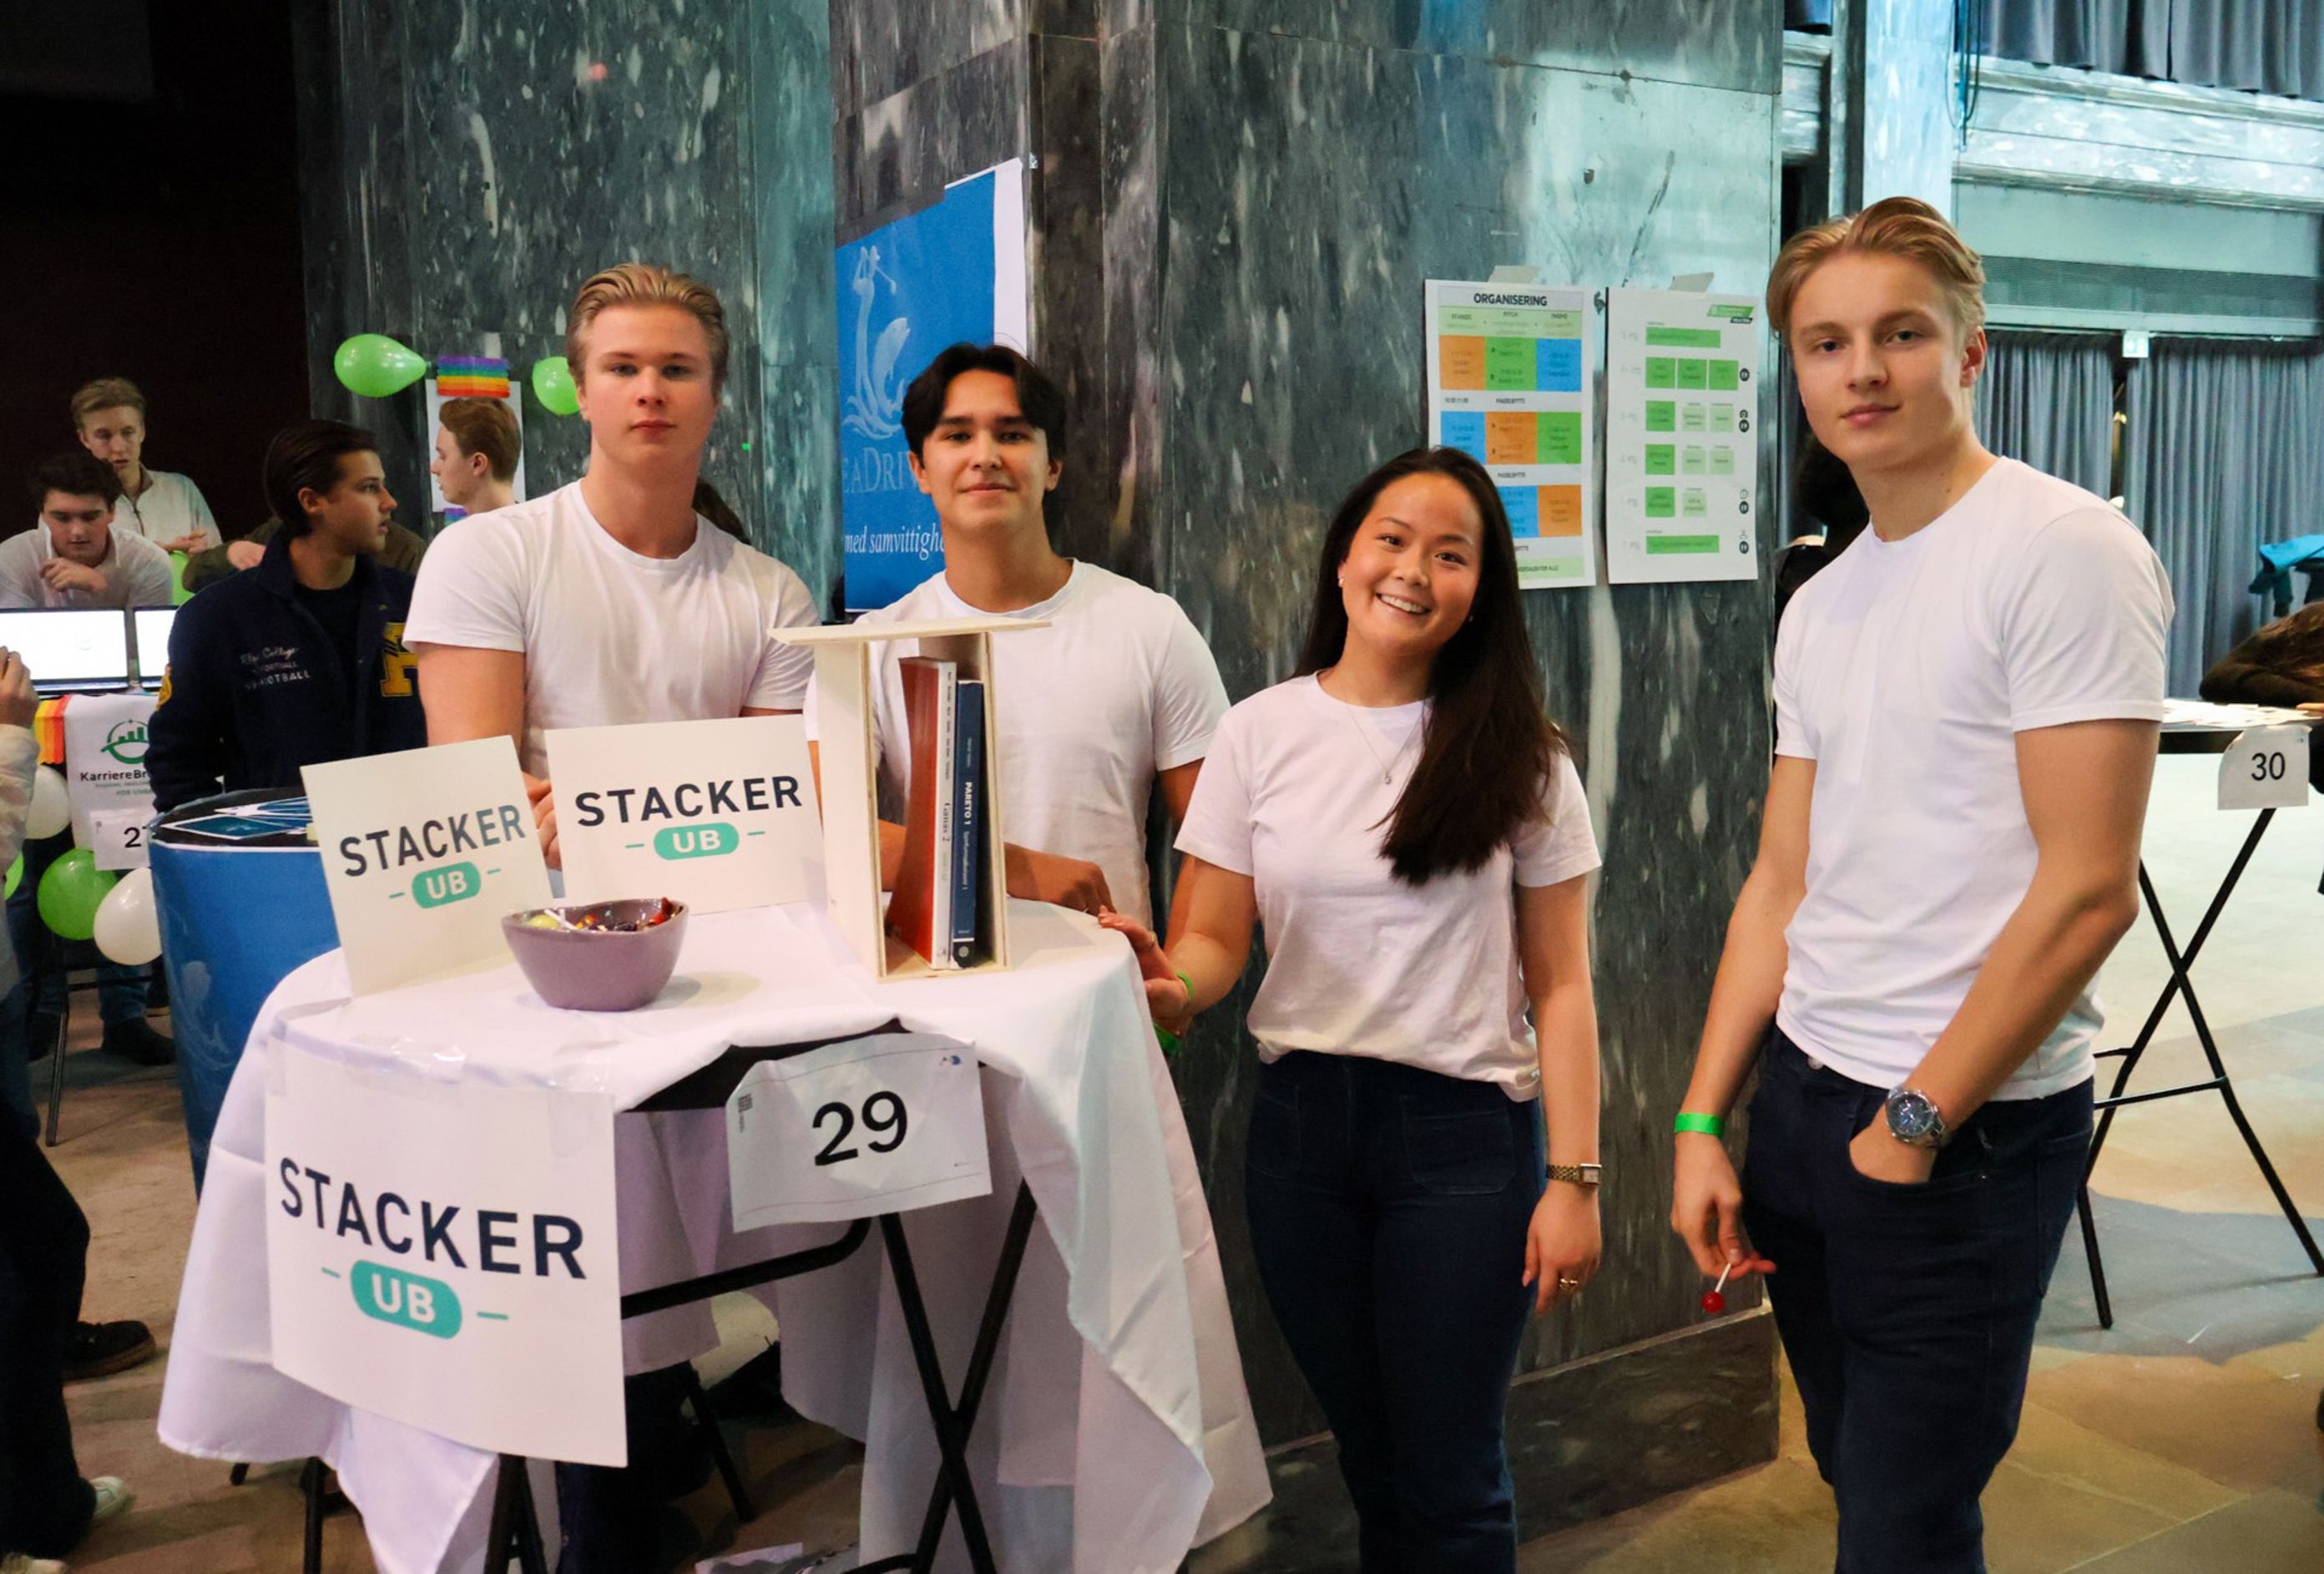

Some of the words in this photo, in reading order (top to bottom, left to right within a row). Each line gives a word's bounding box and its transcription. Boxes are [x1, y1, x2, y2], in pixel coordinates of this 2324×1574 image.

[1473, 293, 1548, 306] ORGANISERING
[80, 769, 147, 782] KarriereBr
[2251, 752, 2286, 781] 30
[574, 775, 802, 827] STACKER
[964, 782, 973, 818] PARETO
[339, 803, 526, 877] STACKER
[672, 828, 721, 854] UB
[425, 869, 467, 900] UB
[811, 1091, 908, 1167] 29
[280, 1156, 588, 1280] STACKER
[371, 1272, 436, 1324] UB
